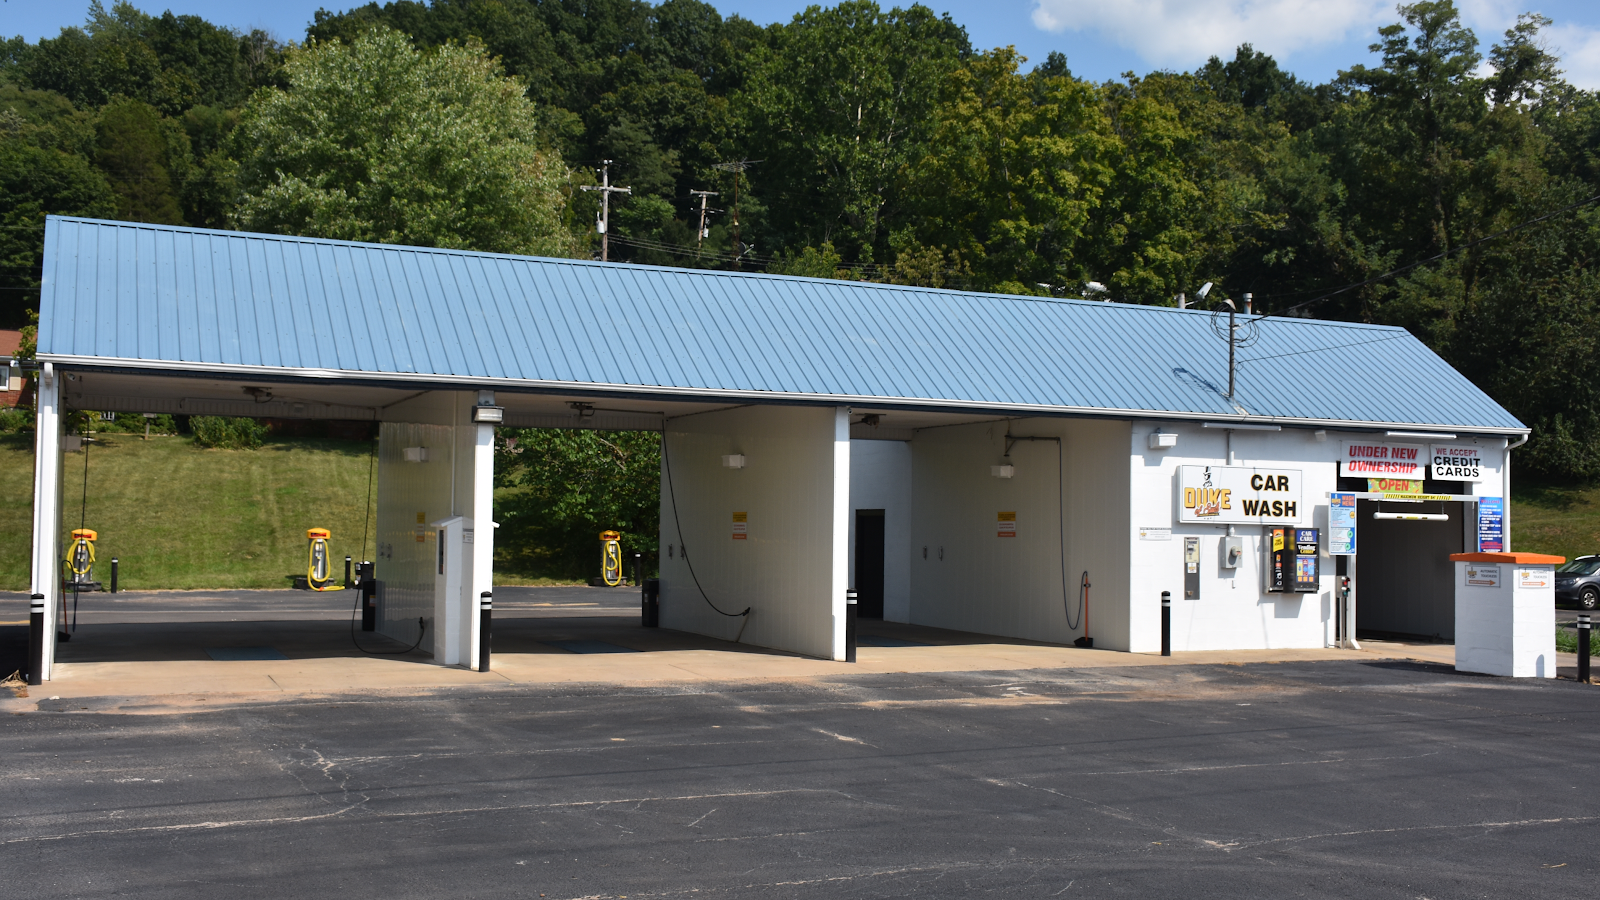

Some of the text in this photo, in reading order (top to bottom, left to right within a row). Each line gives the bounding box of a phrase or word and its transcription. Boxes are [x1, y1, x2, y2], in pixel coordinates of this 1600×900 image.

[1349, 445, 1418, 460] UNDER NEW
[1435, 447, 1478, 457] WE ACCEPT
[1348, 460, 1418, 474] OWNERSHIP
[1433, 455, 1481, 467] CREDIT
[1436, 466, 1480, 478] CARDS
[1250, 474, 1289, 492] CAR
[1378, 478, 1410, 491] OPEN
[1184, 487, 1232, 510] DUKE
[1242, 499, 1297, 517] WASH
